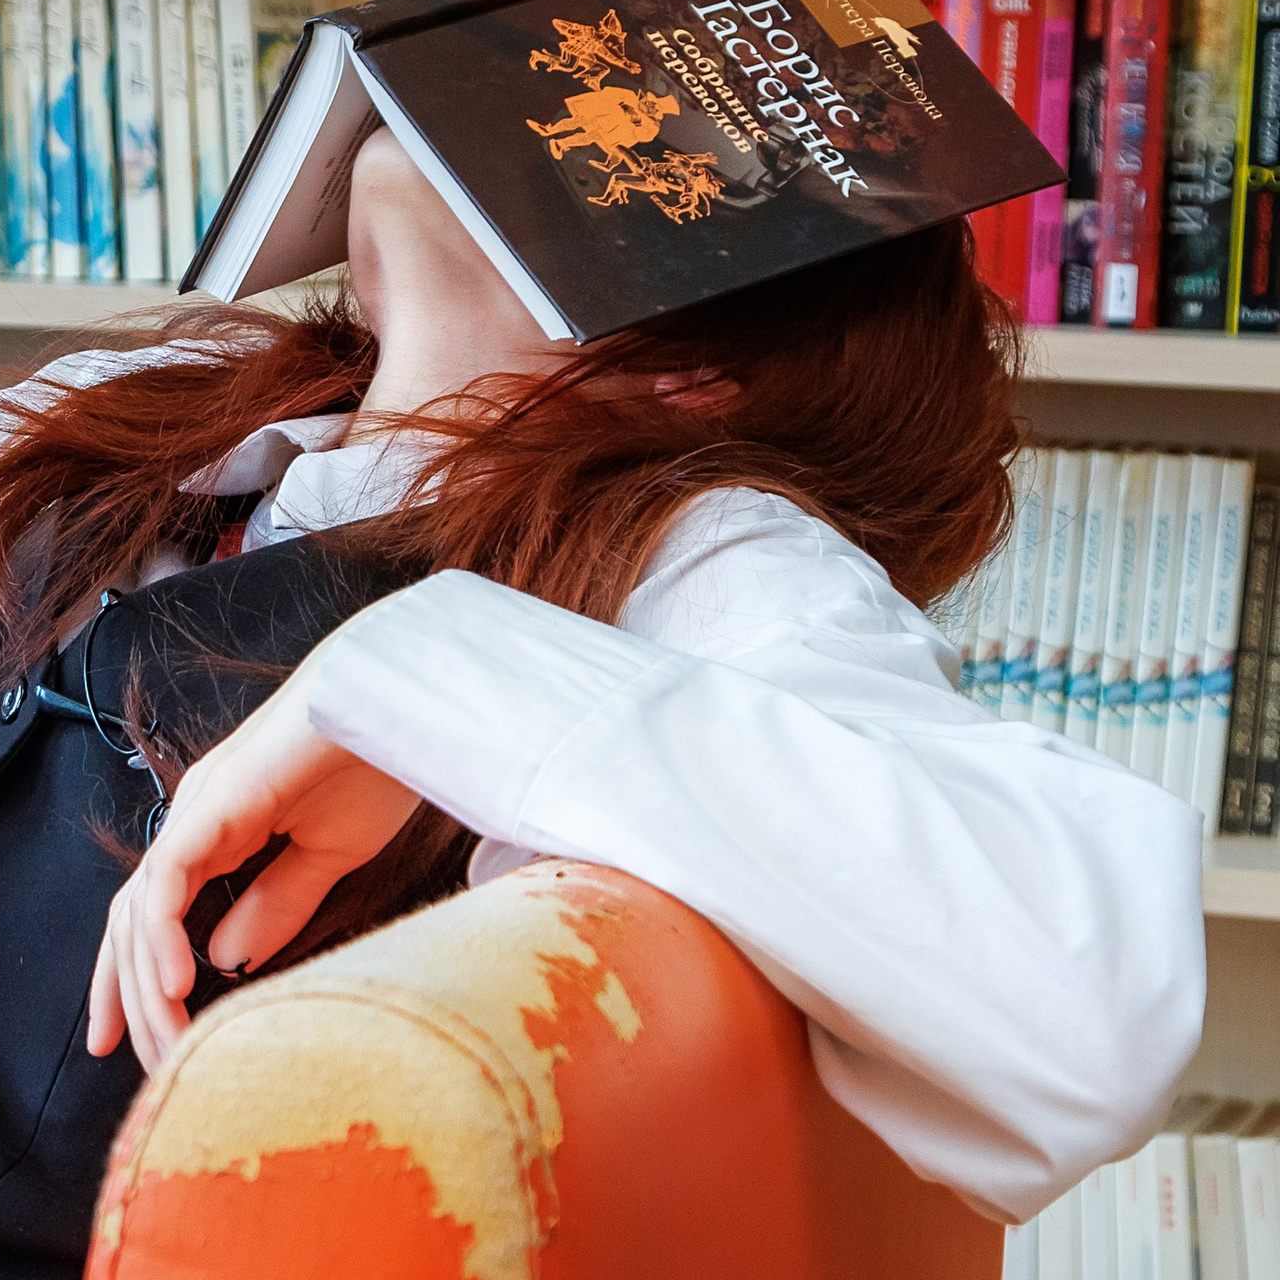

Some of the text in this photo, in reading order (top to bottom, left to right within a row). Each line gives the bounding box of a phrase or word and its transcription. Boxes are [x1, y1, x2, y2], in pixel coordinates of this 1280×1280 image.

[646, 30, 754, 154] переводов
[672, 28, 770, 144] Собрание
[871, 38, 944, 121] Перевода
[1169, 70, 1214, 235] КОСТЕЙ
